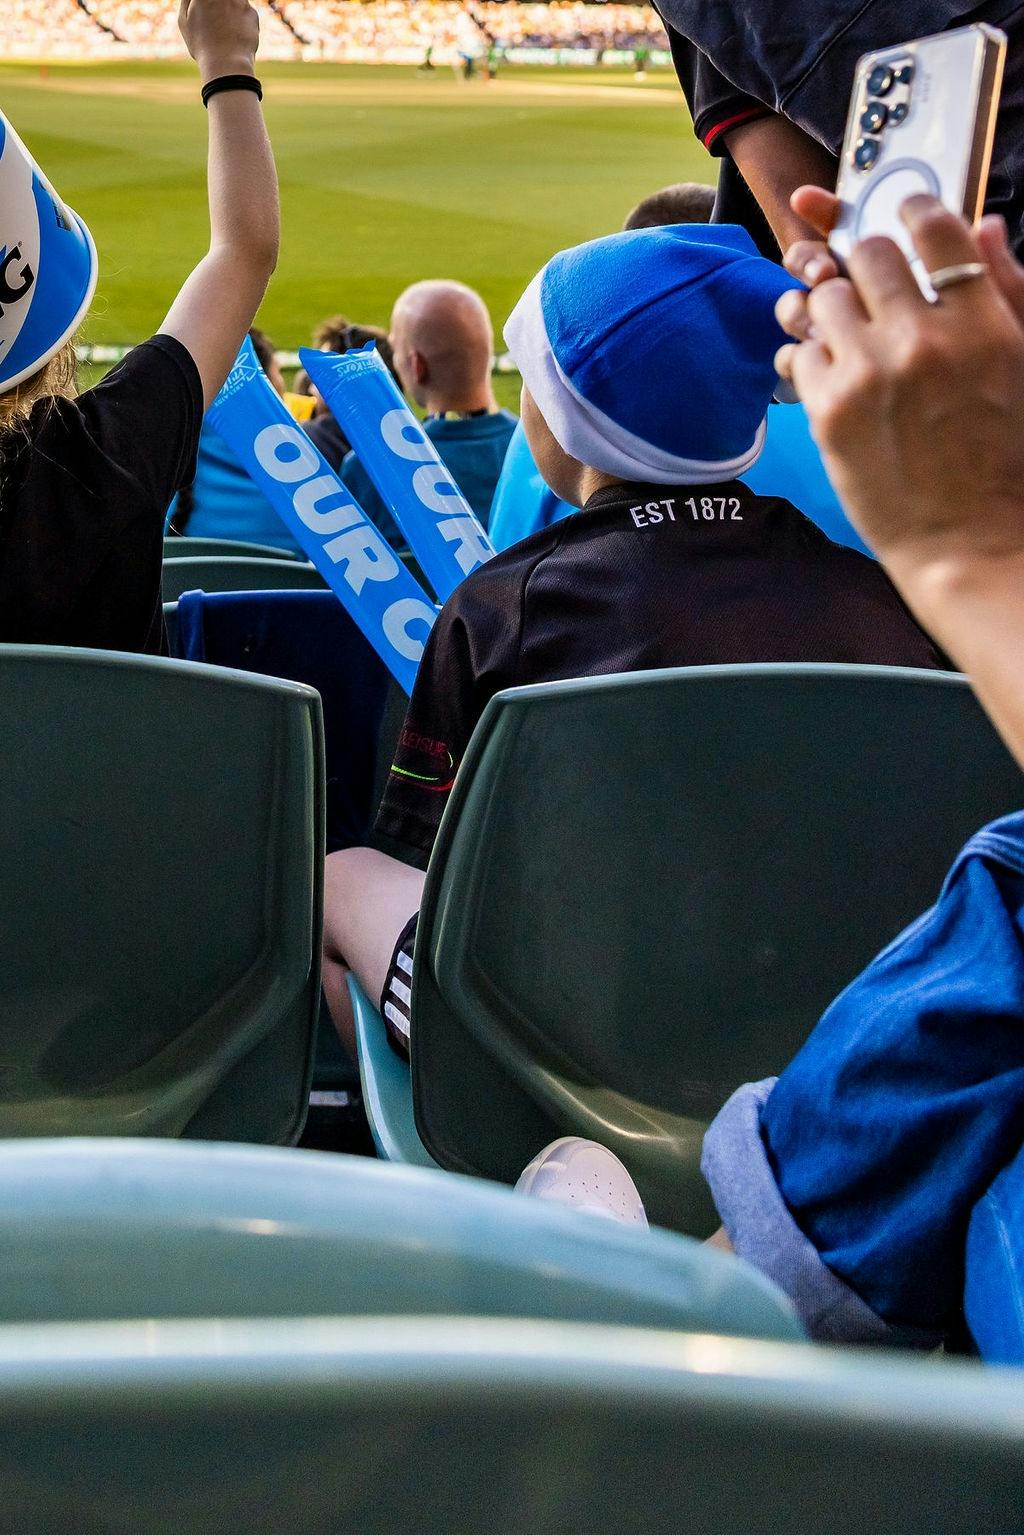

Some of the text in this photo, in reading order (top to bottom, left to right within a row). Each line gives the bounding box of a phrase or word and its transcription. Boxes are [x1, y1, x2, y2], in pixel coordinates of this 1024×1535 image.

[253, 423, 400, 598] OUR
[629, 497, 744, 528] EST 1872
